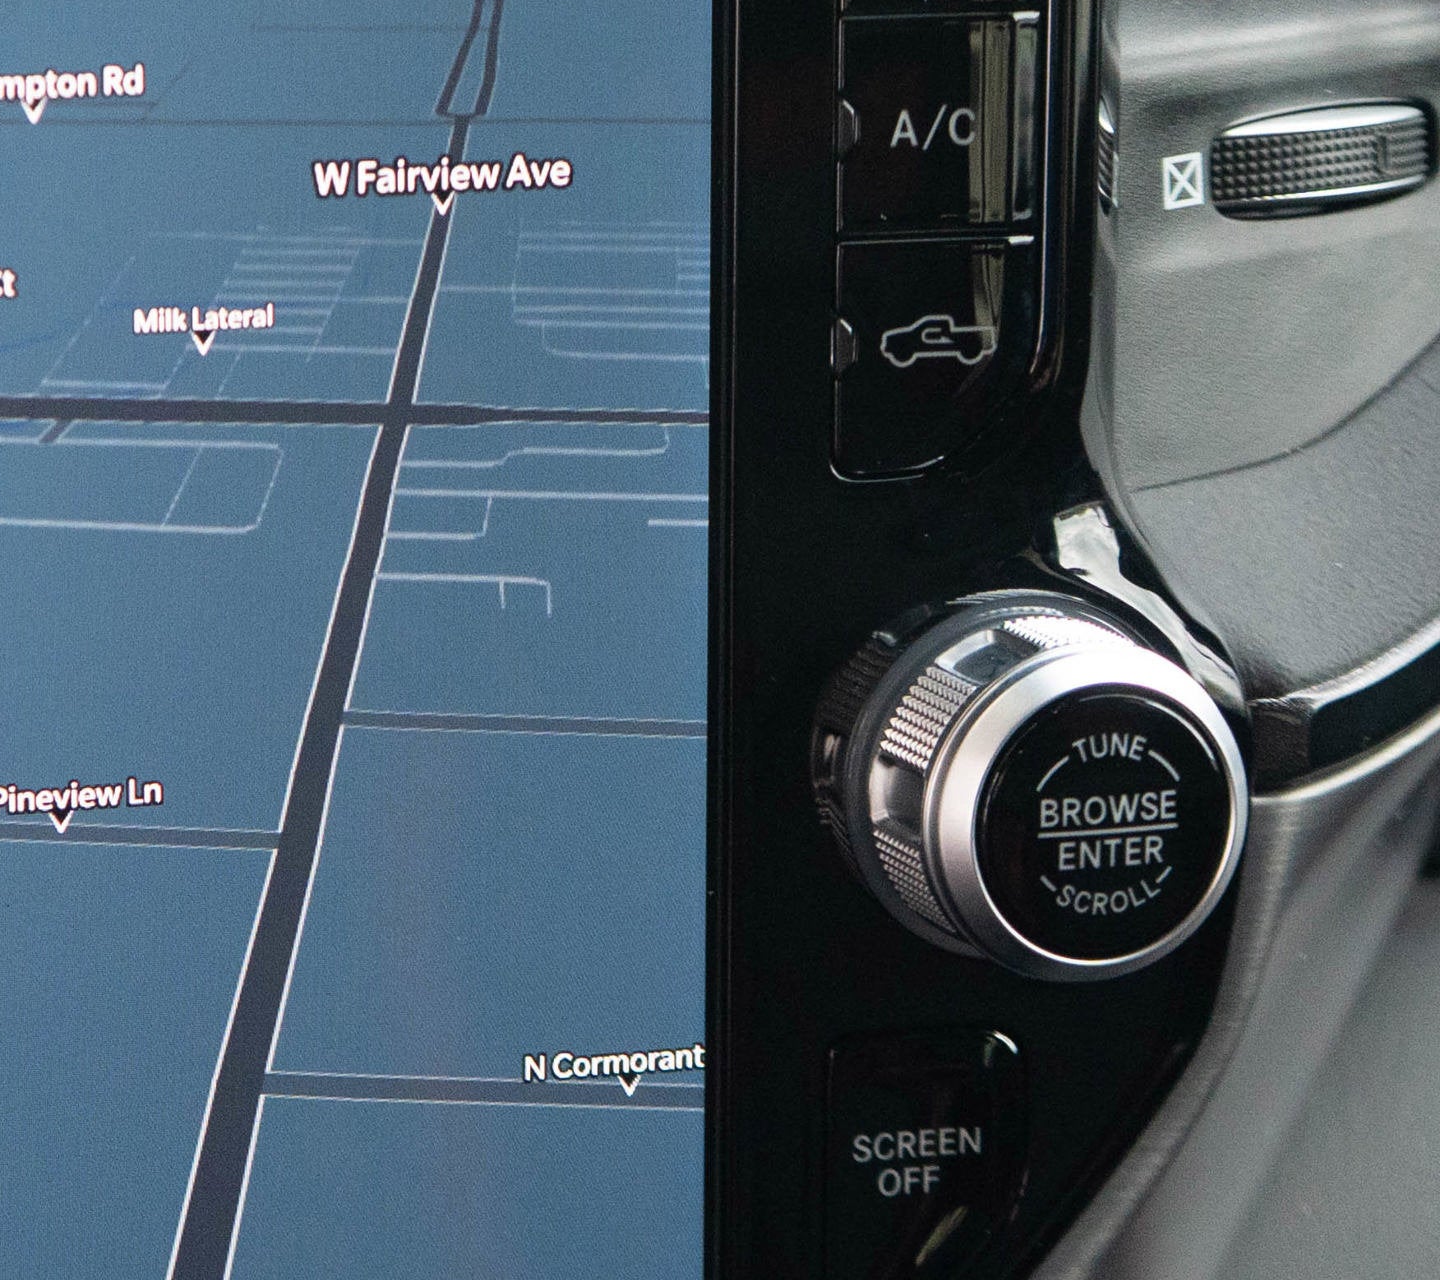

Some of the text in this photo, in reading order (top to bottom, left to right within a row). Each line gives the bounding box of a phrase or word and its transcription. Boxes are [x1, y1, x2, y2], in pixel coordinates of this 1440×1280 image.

[103, 64, 145, 96] Rd
[890, 105, 976, 151] A/C
[314, 153, 573, 197] W Fairview Ave
[133, 303, 274, 334] Milk Lateral
[1072, 732, 1150, 764] TUNE
[127, 778, 162, 808] Ln
[1039, 790, 1178, 828] BROWSE
[1057, 835, 1164, 872] ENTER
[1055, 878, 1160, 916] SCROLL
[523, 1043, 705, 1082] N Cormorant
[852, 1126, 982, 1164] SCREEN
[877, 1166, 941, 1198] OFF
